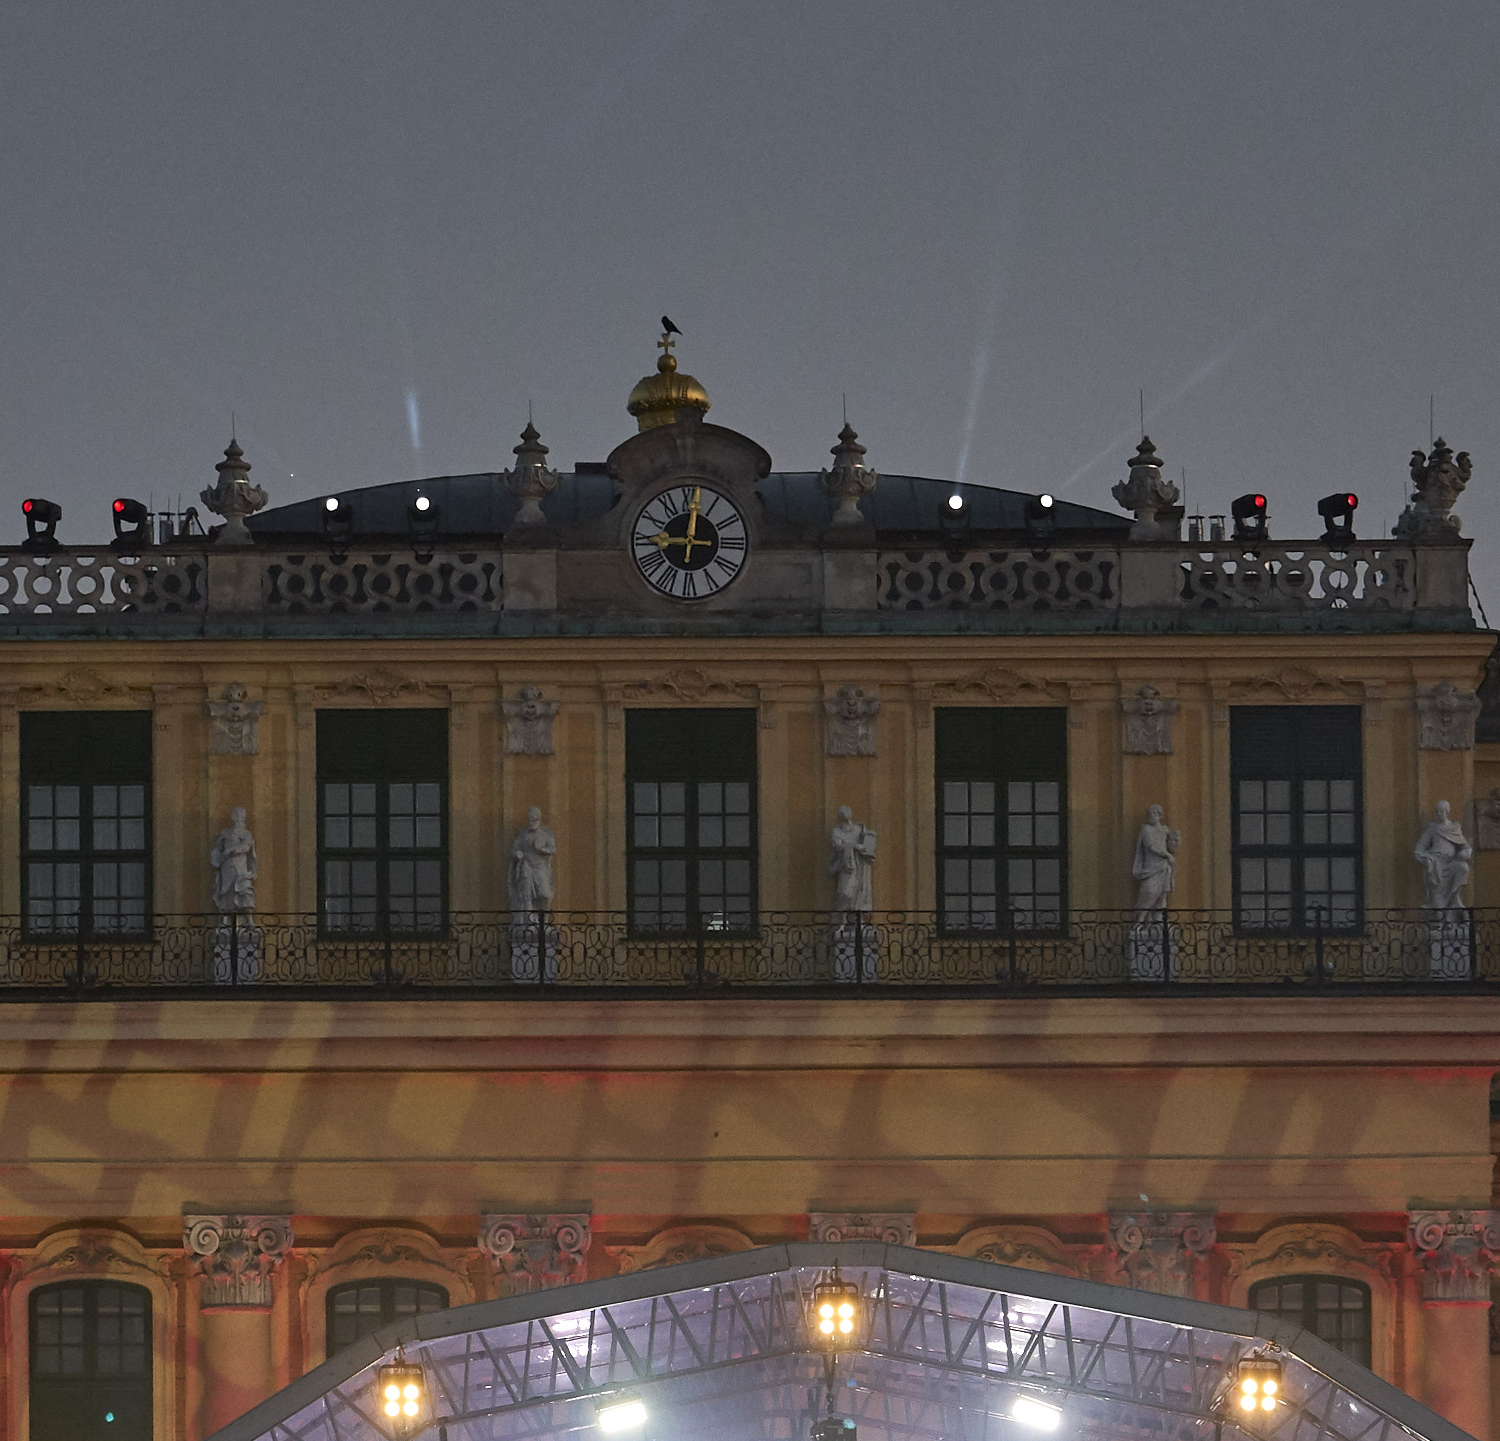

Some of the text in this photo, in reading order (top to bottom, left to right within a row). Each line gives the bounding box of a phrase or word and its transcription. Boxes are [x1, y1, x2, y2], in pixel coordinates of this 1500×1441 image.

[658, 493, 678, 518] XI
[706, 496, 719, 516] I
[642, 510, 665, 529] X
[716, 514, 739, 530] II
[721, 537, 744, 550] III
[704, 569, 719, 591] V
